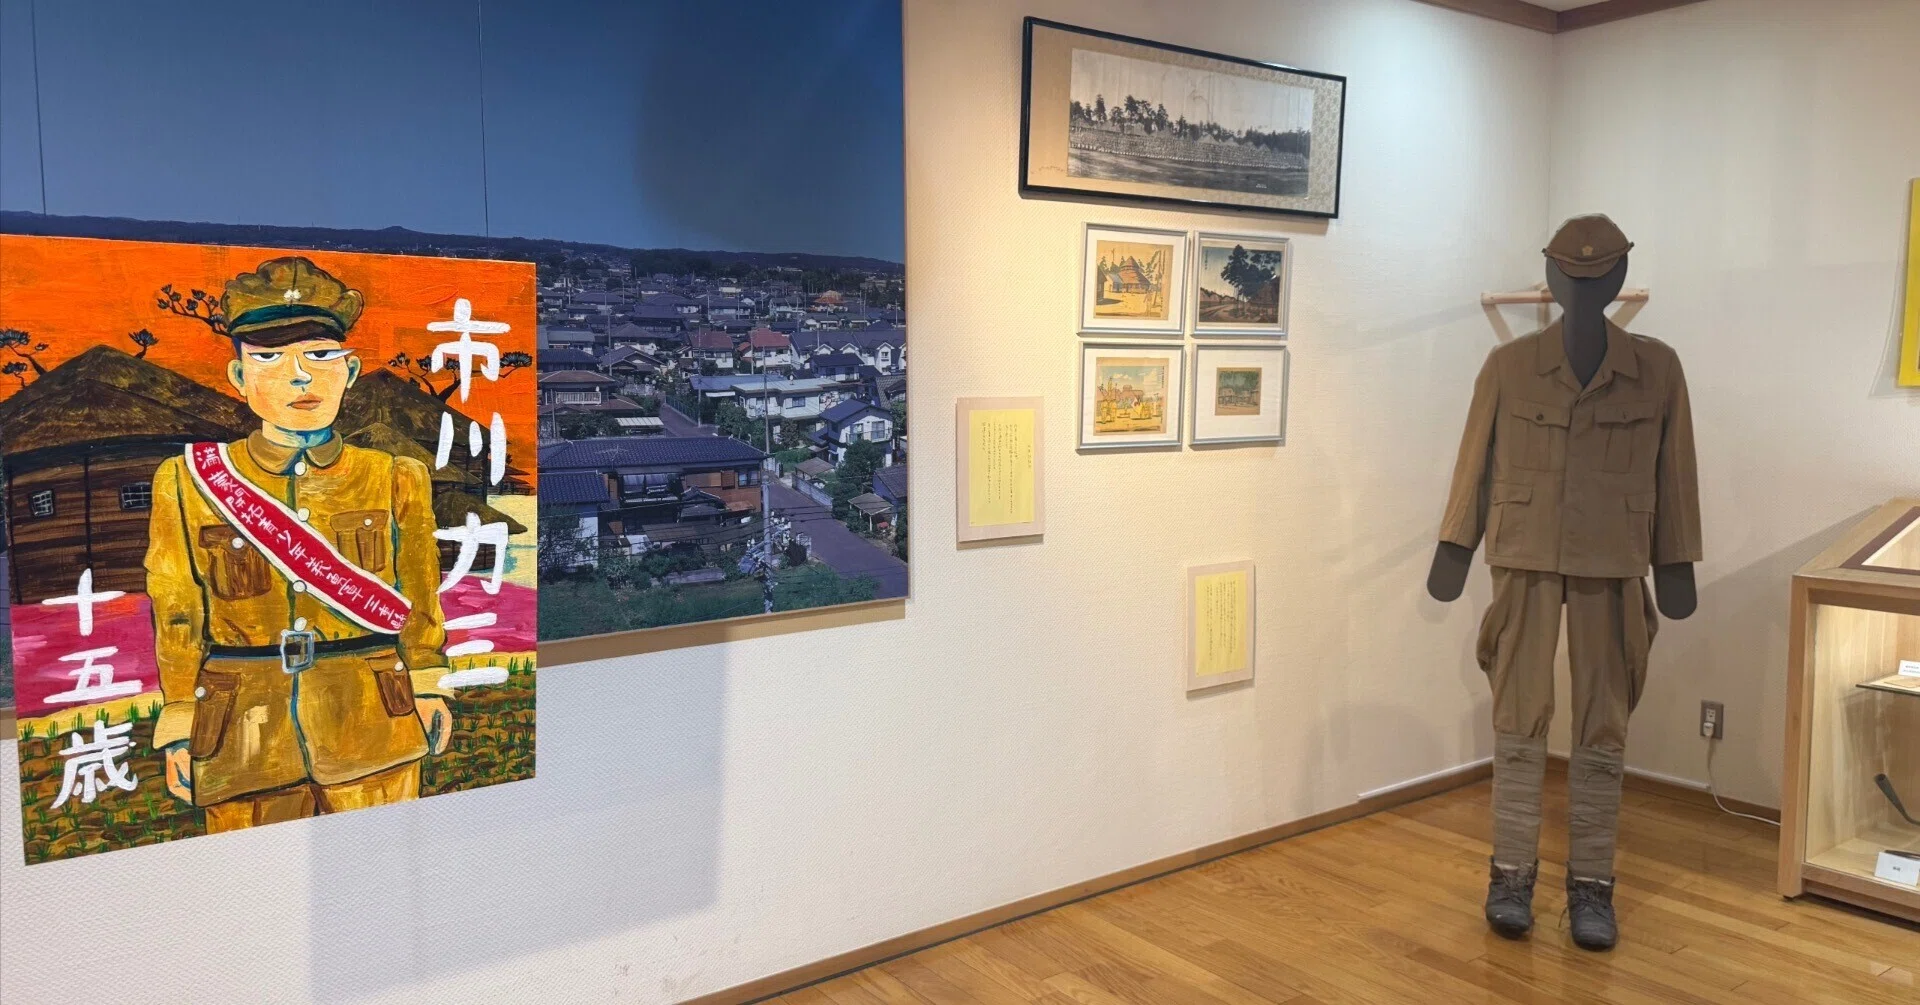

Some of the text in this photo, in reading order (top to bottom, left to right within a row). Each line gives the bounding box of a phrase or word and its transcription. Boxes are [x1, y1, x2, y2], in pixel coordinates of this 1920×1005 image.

[427, 298, 511, 690] 市川力三
[42, 569, 143, 809] 十五歳
